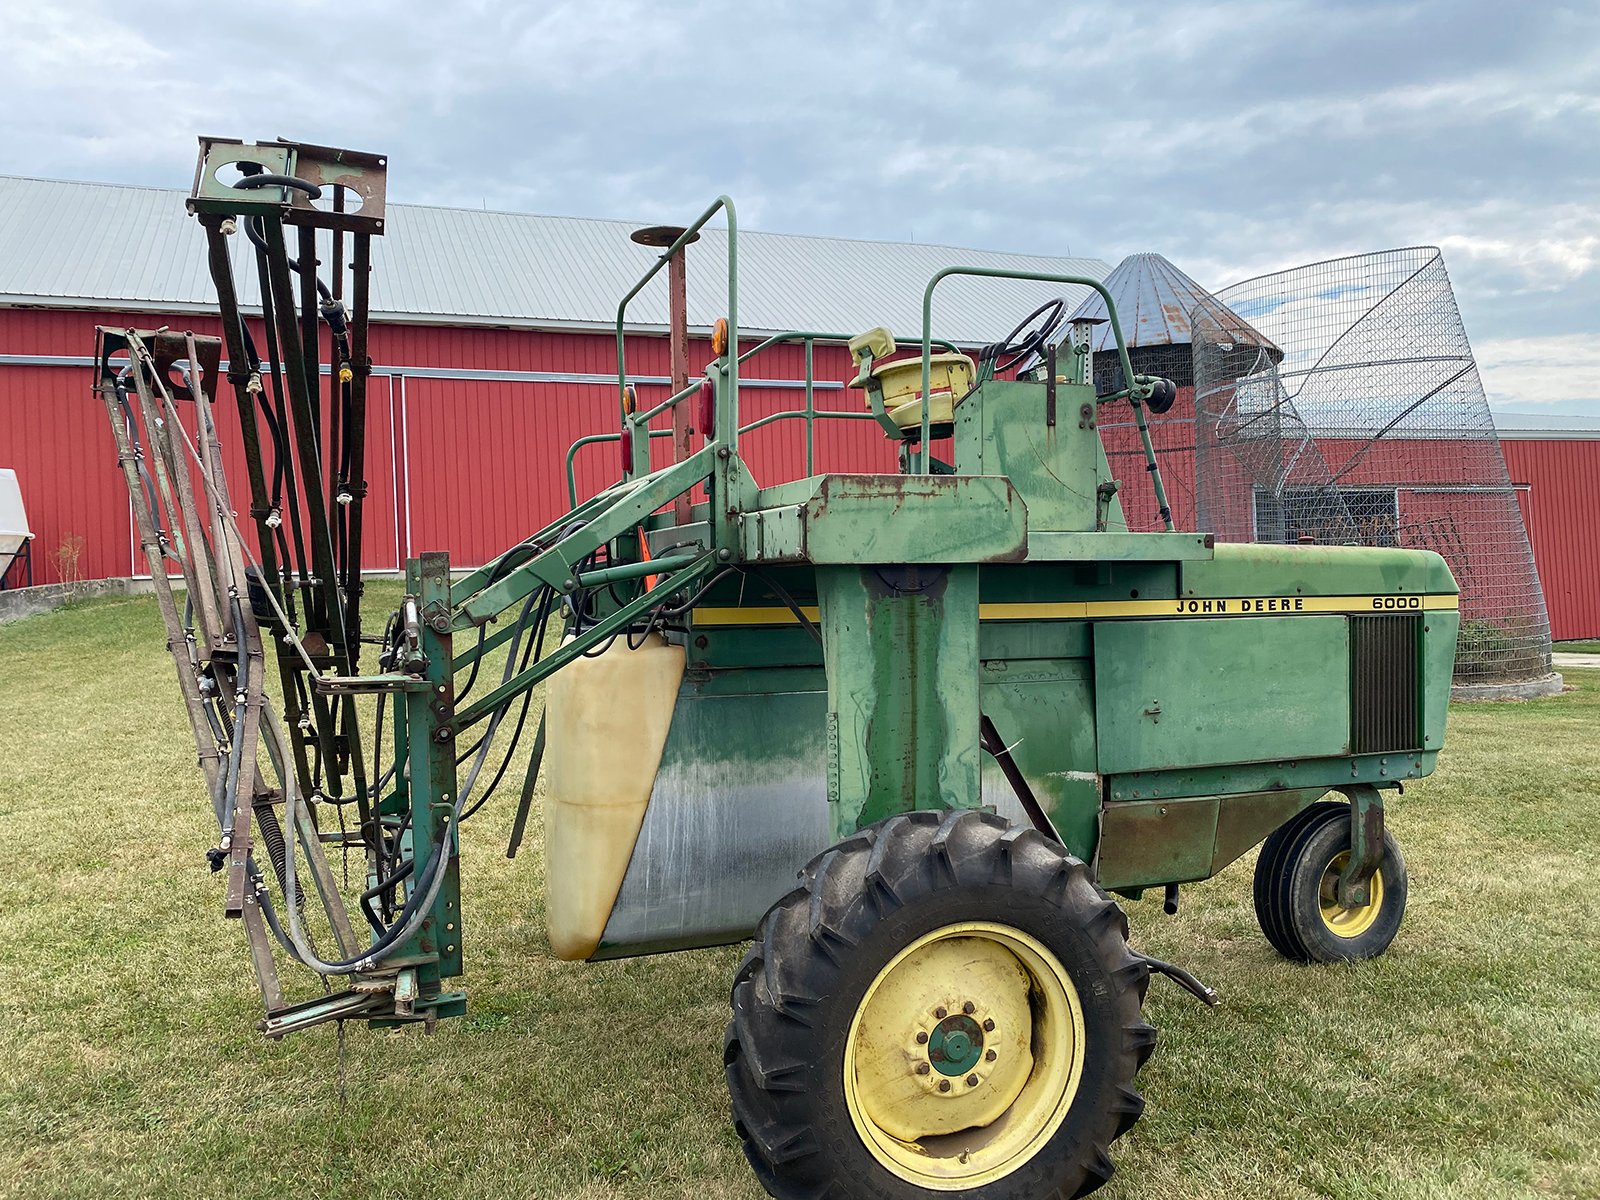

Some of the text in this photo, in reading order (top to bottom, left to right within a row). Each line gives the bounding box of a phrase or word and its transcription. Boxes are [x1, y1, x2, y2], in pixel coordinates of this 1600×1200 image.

[1176, 599, 1303, 613] JOHN DEERE
[1373, 597, 1419, 608] 6000
